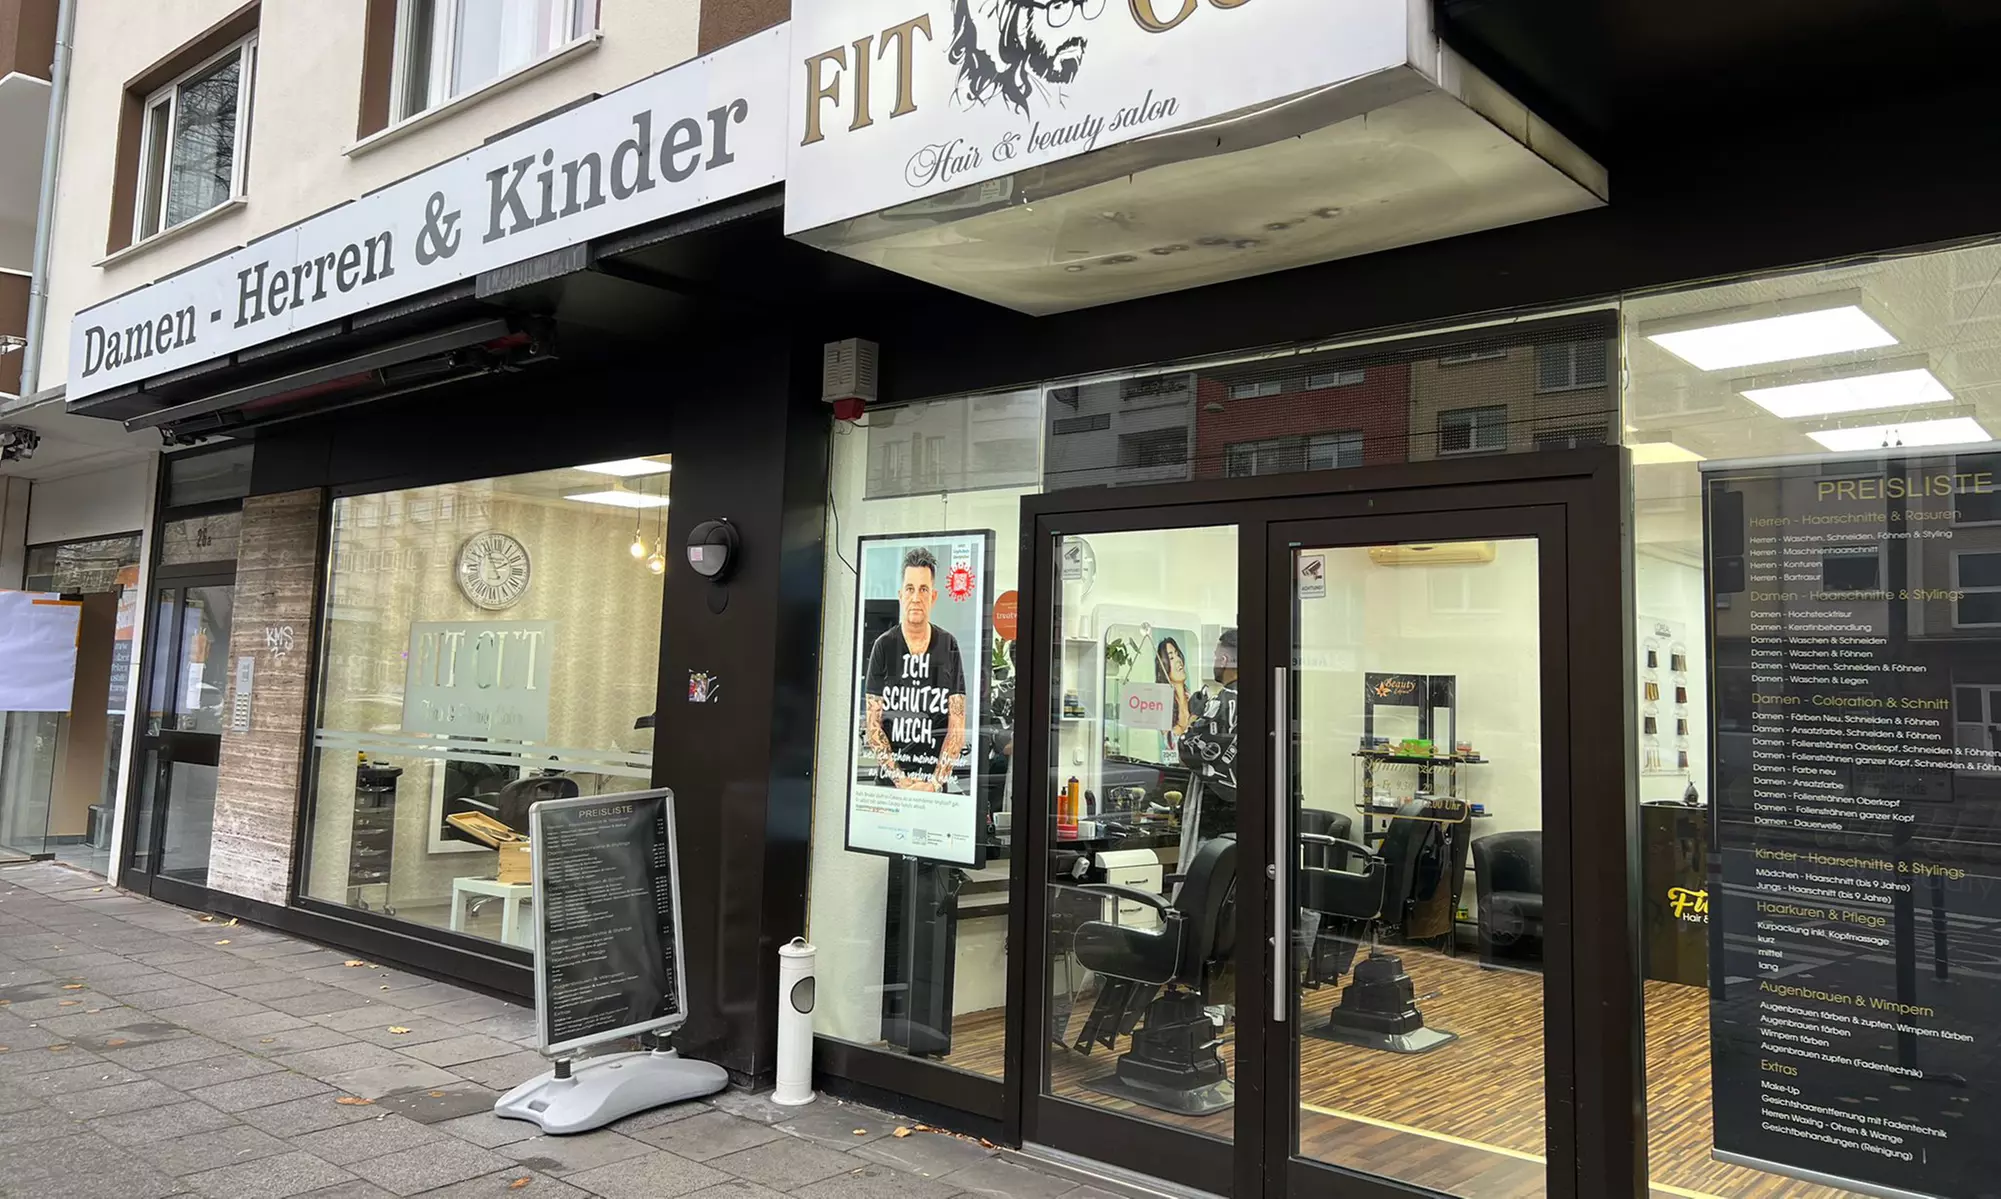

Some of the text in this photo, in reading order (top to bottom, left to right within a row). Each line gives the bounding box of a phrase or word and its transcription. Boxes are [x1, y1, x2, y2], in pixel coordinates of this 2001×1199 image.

[799, 13, 933, 147] FIT
[904, 89, 1179, 189] Hair & beauty salon
[82, 97, 749, 378] Damen - Herren & Kinder
[1817, 473, 1994, 501] PREISLISTE
[1750, 510, 1961, 525] Herren Haarschnitte & Rasuren
[1877, 531, 1911, 539] Föhnen
[1922, 530, 1952, 539] Styling
[1783, 545, 1878, 554] Maschinenhaarschnitt
[1750, 560, 1776, 568] Herren
[1752, 589, 1964, 601] Damen Haarschnitte & Stylings
[1751, 622, 1871, 632] Damen Keratinbehandlung
[1751, 648, 1782, 656] Damen
[901, 653, 930, 679] ICH
[1751, 661, 1782, 669] Damen
[1833, 662, 1880, 670] Schneiden
[1892, 663, 1926, 671] Föhnen
[1752, 674, 1868, 685] Damen Waschen Legen
[882, 680, 950, 714] SCHÜTZE
[1129, 695, 1164, 712] Open
[1752, 694, 1949, 708] Damen Coloration & Schnitt
[1752, 712, 1783, 720] Damen
[1791, 713, 1821, 721] Färben
[1844, 714, 1892, 723] Schneiden
[1904, 716, 1939, 725] Föhnen
[891, 717, 937, 749] MICH,
[1752, 724, 1784, 733] Damen
[1846, 728, 1894, 737] Schneiden
[1906, 730, 1940, 739] Föhnen
[1752, 737, 1784, 746] Damen
[1792, 739, 1853, 749] Foliensträhnen
[1902, 744, 1952, 753] Schneiden
[891, 748, 911, 762] schon
[912, 752, 939, 765] meinen
[1753, 750, 1784, 759] Damen
[1792, 752, 1853, 762] Foliensträhnen
[1855, 757, 1886, 765] ganzer
[1914, 758, 1965, 768] Schneiden
[1753, 763, 1785, 772] Damen
[1792, 765, 1817, 773] Farbe
[1753, 776, 1843, 788] Damen Ansatzfarbe
[1445, 800, 1461, 810] Uhr
[1753, 790, 1900, 807] Damen Foliensträhnen Oberkopf
[578, 805, 633, 818] PREISLISTE
[1754, 803, 1914, 822] Damen Foliensträhnen ganzer Kopf
[1755, 816, 1842, 829] Damen Dauerwelle
[1755, 849, 1965, 878] Kinder Haarschnitte & Stylings
[1756, 868, 1910, 892] Mädchen Haarschnitt (bis 9 Jahre)
[1756, 881, 1891, 903] Jungs Haarschnitt (bis Jahre)
[1682, 912, 1702, 923] Hair
[1757, 901, 1885, 926] Haarkuren & Pflege
[1757, 921, 1808, 937] Kurpackung
[1829, 930, 1889, 945] Kopfmassage
[1758, 934, 1774, 943] kurz
[1758, 948, 1782, 957] mittel
[1758, 960, 1778, 972] lang
[1759, 981, 1933, 1015] Augenbrauen & Wimpern
[1760, 1001, 1819, 1018] Augenbrauen
[1820, 1010, 1850, 1022] färben
[1896, 1022, 1938, 1036] Wimpern
[1941, 1029, 1973, 1041] färben
[1760, 1014, 1850, 1036] Augenbrauen färben
[1760, 1027, 1829, 1046] Wimpern färben
[1760, 1041, 1922, 1079] Augenbrauen zupfen (Fadentechnik)
[1761, 1058, 1798, 1076] Extras
[1761, 1080, 1799, 1096] Make-Up
[1761, 1094, 1947, 1136] Gesichtshaarentfernung mit Fadentechnik
[1762, 1108, 1903, 1143] Herren Waxing Ohren Wange
[1861, 1141, 1912, 1161] (Reinigung)
